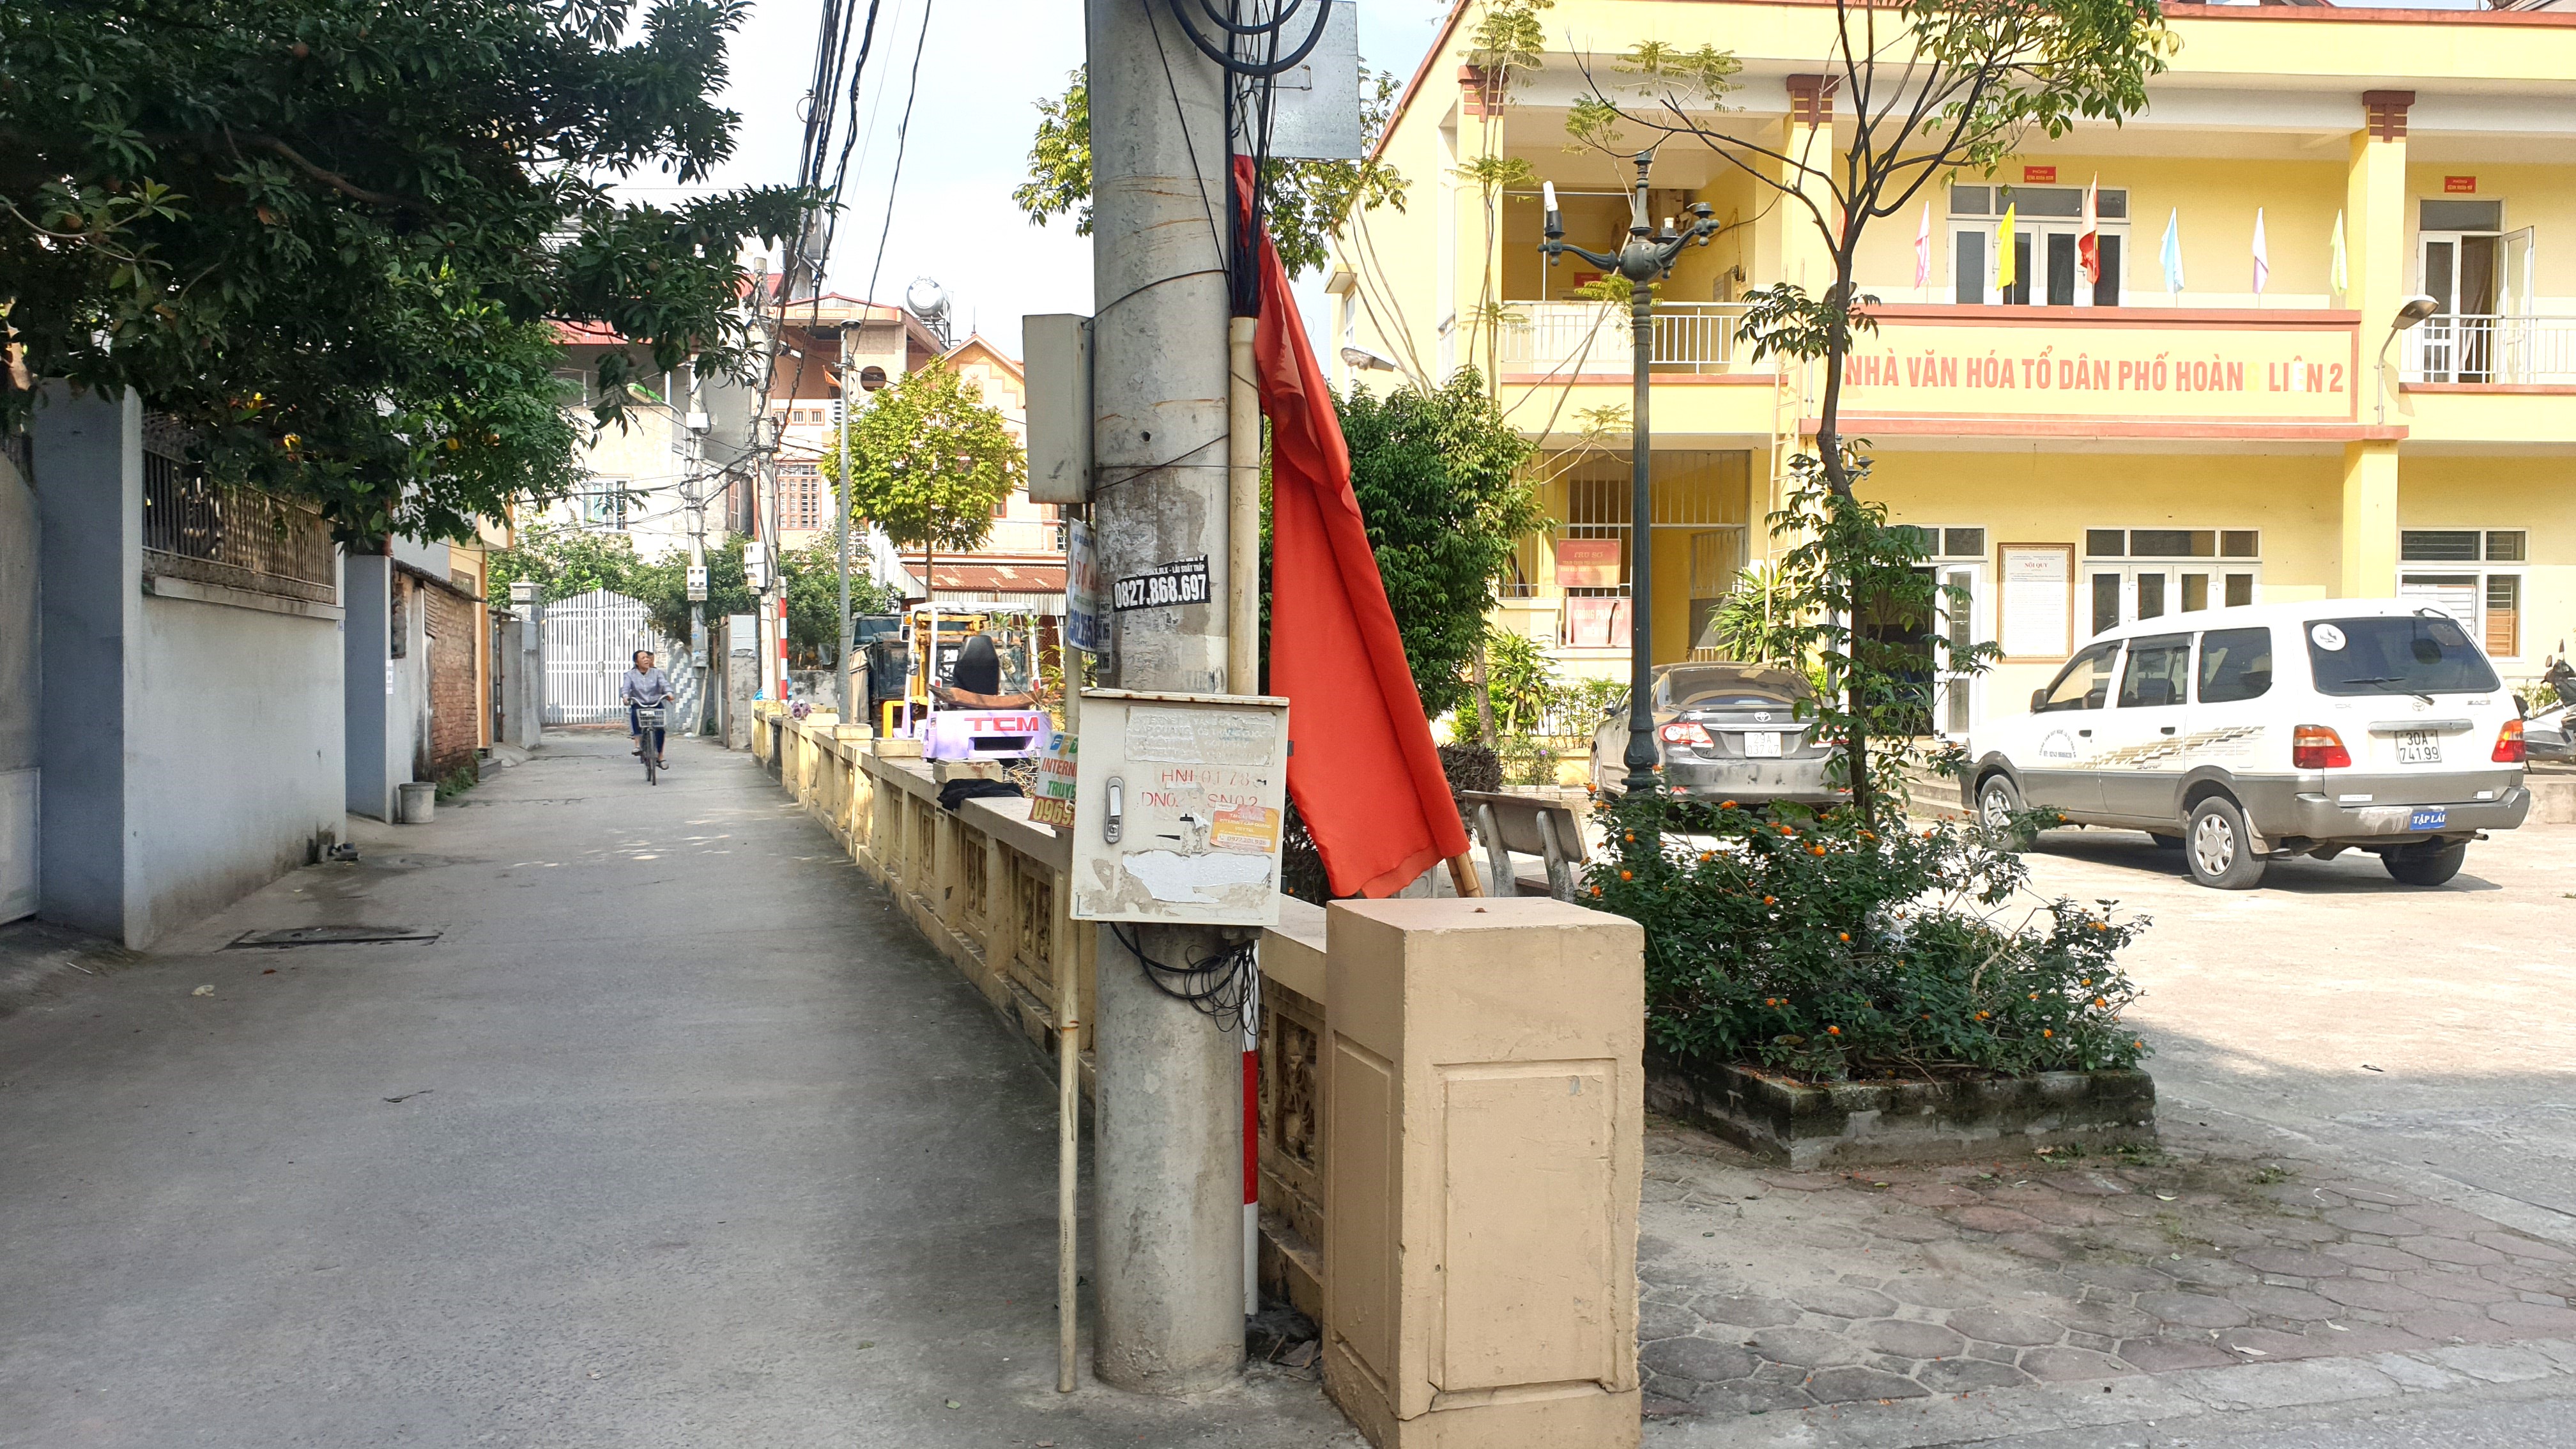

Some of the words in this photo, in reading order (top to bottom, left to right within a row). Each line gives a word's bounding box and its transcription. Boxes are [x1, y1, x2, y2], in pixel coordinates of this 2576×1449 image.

[1846, 348, 1899, 386] NHÀ
[1906, 349, 1958, 387] VĂN
[1967, 349, 2015, 388] HÓA
[2022, 345, 2053, 389] TỔ
[2059, 353, 2110, 390] DÂN
[2119, 351, 2170, 391] PHỐ
[2329, 363, 2343, 392] 2
[1114, 574, 1206, 608] 0827.868.697
[964, 717, 1039, 732] TCM
[1754, 733, 1772, 744] 29A
[2407, 732, 2428, 746] 30A
[2400, 746, 2439, 762] 741.99
